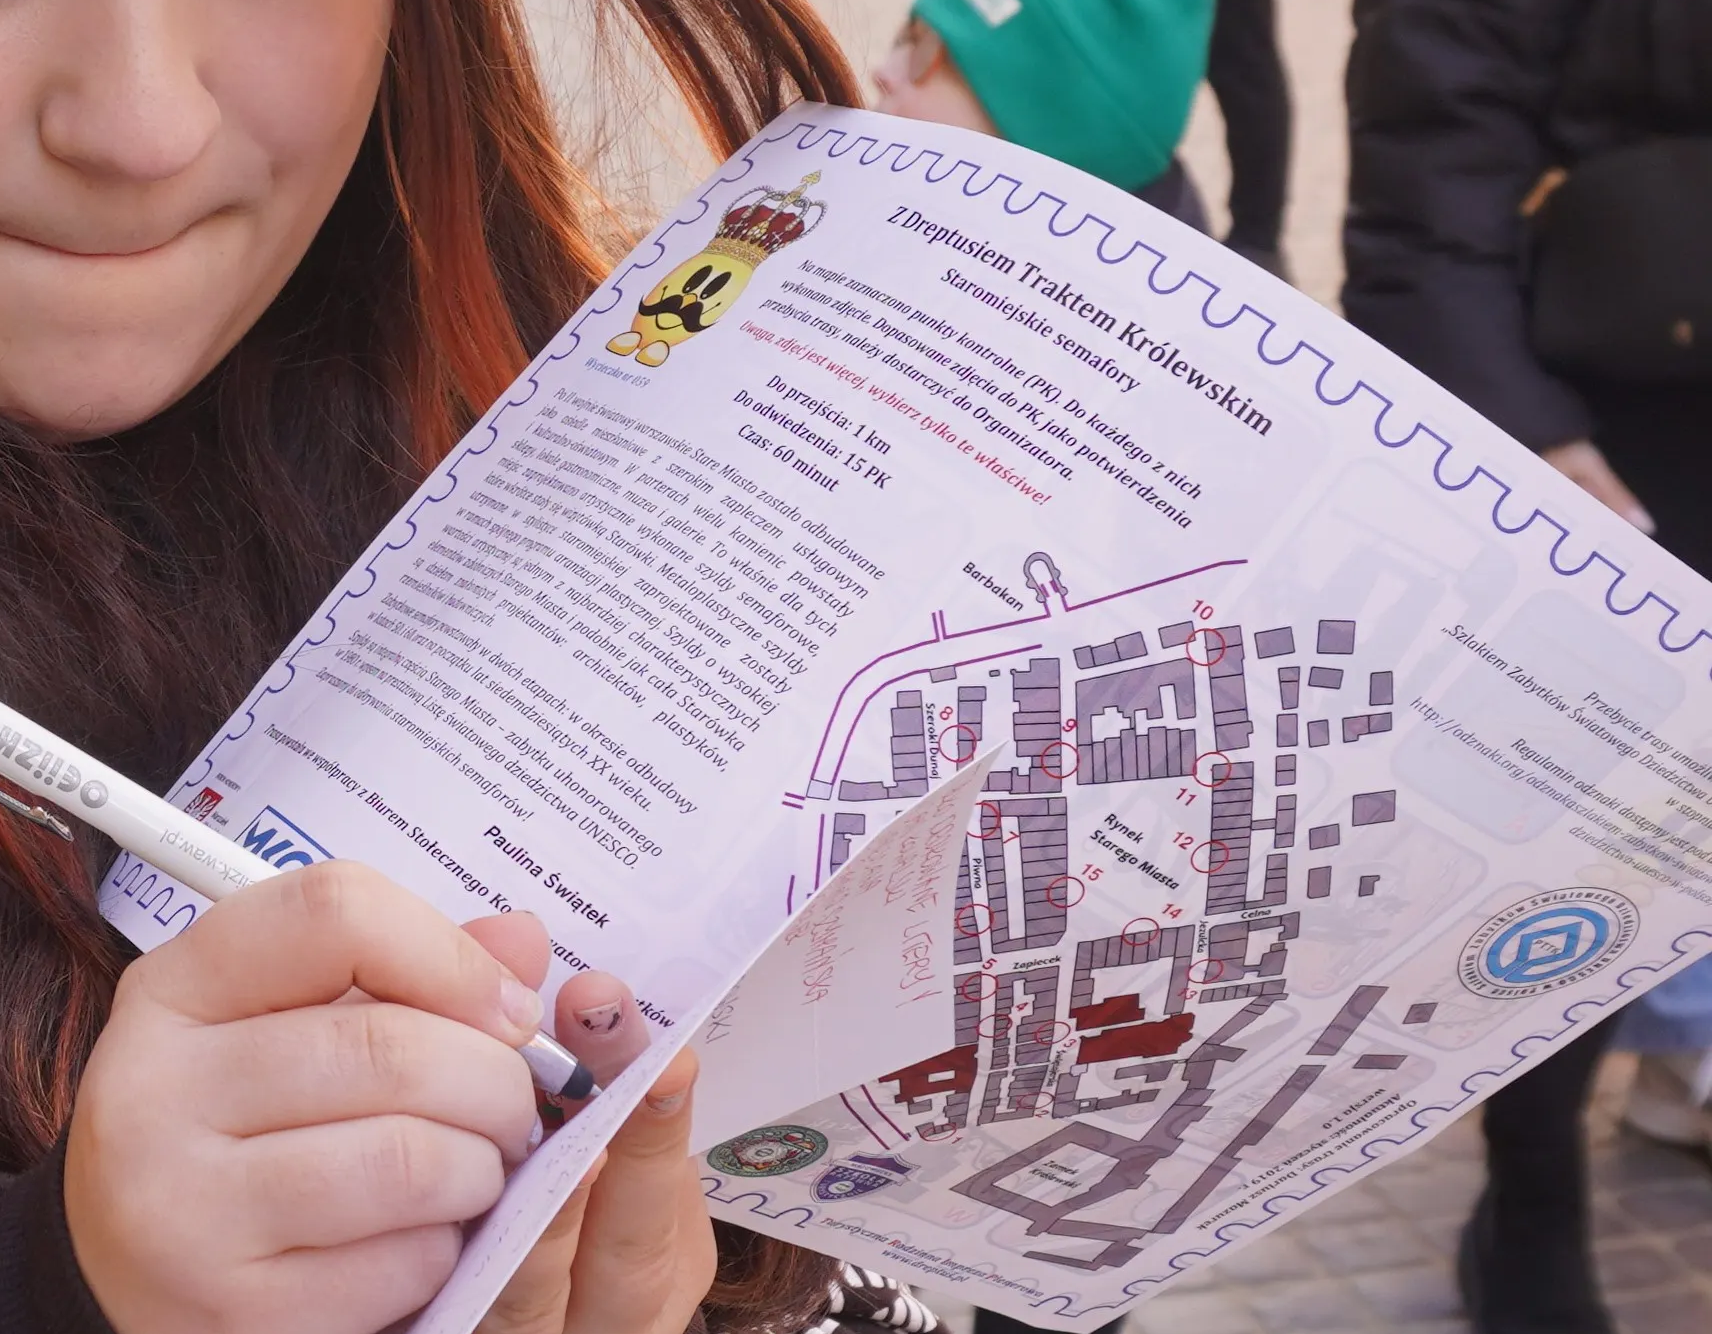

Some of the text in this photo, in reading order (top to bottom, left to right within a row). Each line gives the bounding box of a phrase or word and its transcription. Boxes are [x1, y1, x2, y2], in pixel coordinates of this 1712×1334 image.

[797, 258, 1202, 500] Na mapie zaznaczono punkty kontrolne (PK). Do każdego nich
[885, 205, 1273, 437] Z Dreptusiem Traktem Królewskim
[939, 267, 1141, 393] Staromiejskie semafory
[732, 388, 893, 490] Do odwiedzenia: 15 PK
[738, 319, 1053, 506] Uwaga, zdjęć jest więcej, wybierz tylko właściwe!
[758, 298, 1074, 482] przebycia trasy, należy dostarczyć Organizatora.
[765, 374, 892, 455] Do przejścia: 1 km
[780, 279, 1192, 529] wykonano zdjęcie. Dopasowane zdjęcia PK, jako potwierdzenia
[688, 447, 886, 581] Stare Miasto zostało odbudowane
[737, 423, 839, 492] Czas: 60 minut
[621, 489, 838, 638] muzea galerie. właśnie tych
[633, 472, 855, 618] parterach wielu kamienic powstały
[636, 523, 820, 658] wykonane szyldy semaforowe,
[664, 462, 869, 600] szerokim zapleczem usługowym
[962, 561, 1025, 612] Barbakan
[552, 552, 781, 716] aranżacji plastycznej. Szyldy wysokiej
[557, 529, 793, 695] staromiejskiej zaprojektowane zostały
[563, 586, 761, 733] najbardziej charakterystycznych
[604, 529, 809, 676] Starówki. Metaloplastyczne szyldy
[1191, 599, 1214, 620] 10
[487, 651, 698, 815] dwóch etapach: okresie odbudowy
[493, 598, 729, 773] projektantów: architektów, plastyków,
[530, 589, 746, 752] Miasta podobnie Starówka
[939, 706, 954, 721] 8
[1062, 718, 1078, 733] 9
[1440, 623, 1708, 800] „Szlakiem Zabytków Światowego Dziedzictwa
[1582, 690, 1674, 754] Przebycie trasy
[388, 711, 535, 822] staromiejskich semaforów!
[423, 670, 663, 857] Starego Miasta zabytku uhonorowanego
[441, 711, 639, 870] światowego dziedzictwa UNESCO.
[484, 679, 652, 812] siedemdziesiątych XX wieku.
[925, 703, 941, 779] Szeroki Dunaj
[1175, 787, 1197, 807] 11
[1509, 737, 1671, 839] Regulamin odznaki dostępny
[310, 753, 490, 897] współpracy Biurem Stołecznego
[482, 824, 610, 929] Paulina Świątek
[972, 858, 983, 889] Piwna
[1080, 863, 1104, 881] 15
[1090, 829, 1180, 891] Starego Miasta
[1103, 813, 1145, 845] Rynek
[1172, 831, 1195, 850] 12
[1012, 954, 1062, 970] Zapiecek
[1161, 903, 1184, 919] 14
